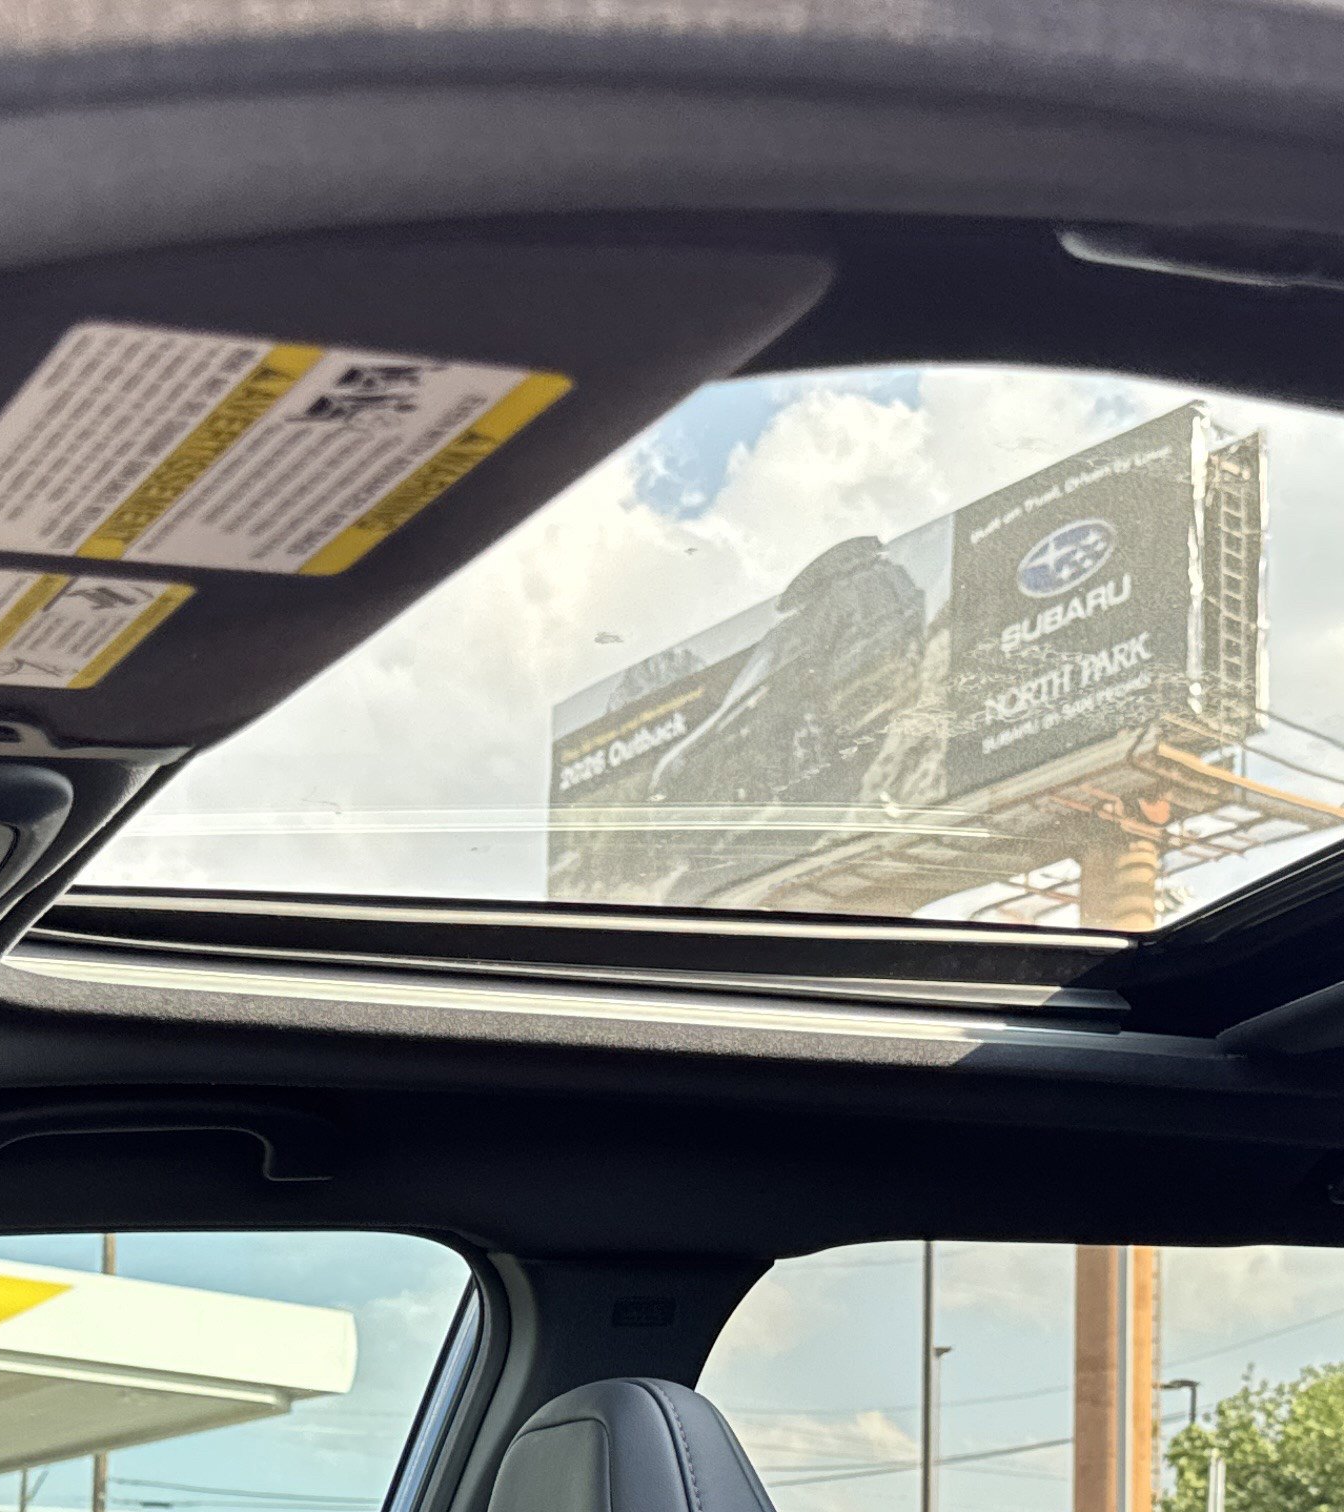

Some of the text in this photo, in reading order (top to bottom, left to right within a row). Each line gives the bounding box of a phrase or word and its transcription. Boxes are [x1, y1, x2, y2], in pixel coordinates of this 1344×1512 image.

[1000, 572, 1132, 655] SUBARU
[984, 631, 1153, 726] NORTH PARK
